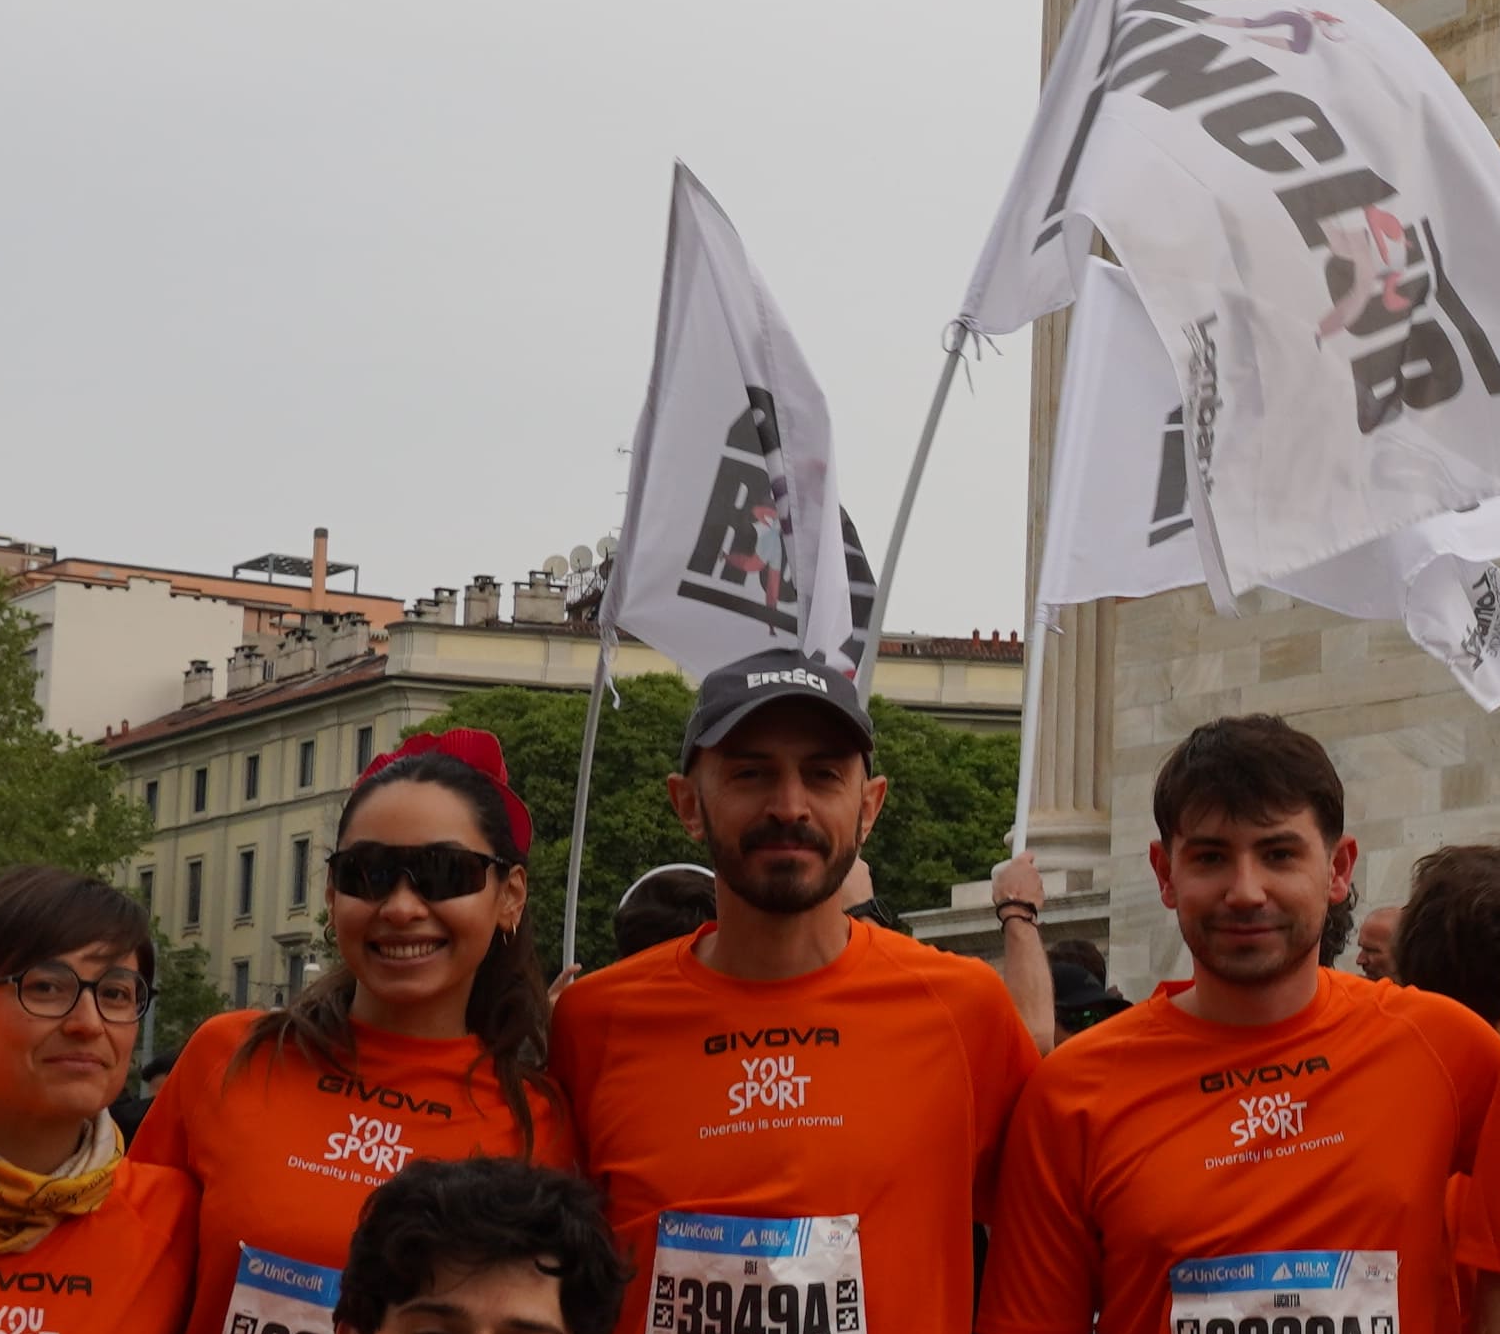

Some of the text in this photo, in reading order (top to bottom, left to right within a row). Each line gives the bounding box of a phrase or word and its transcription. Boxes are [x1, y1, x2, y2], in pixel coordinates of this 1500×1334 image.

[704, 1027, 840, 1055] GIVOVA
[741, 1055, 794, 1086] YOU
[1199, 1055, 1331, 1094] GIVOVA
[318, 1074, 452, 1120] GIVOVA
[729, 1075, 811, 1115] SPORT
[1239, 1091, 1291, 1123] YOU
[349, 1113, 402, 1146] YOU
[699, 1114, 843, 1139] Diversity is our normal
[1230, 1101, 1307, 1148] SPORT
[324, 1132, 413, 1173] SPORT
[1204, 1131, 1345, 1170] Diversity is our normal
[288, 1155, 347, 1182] Diversity
[350, 1170, 362, 1183] is
[679, 1223, 724, 1241] UniCredit
[264, 1264, 324, 1293] UniCredit
[1194, 1261, 1330, 1284] UniCredit RELAY
